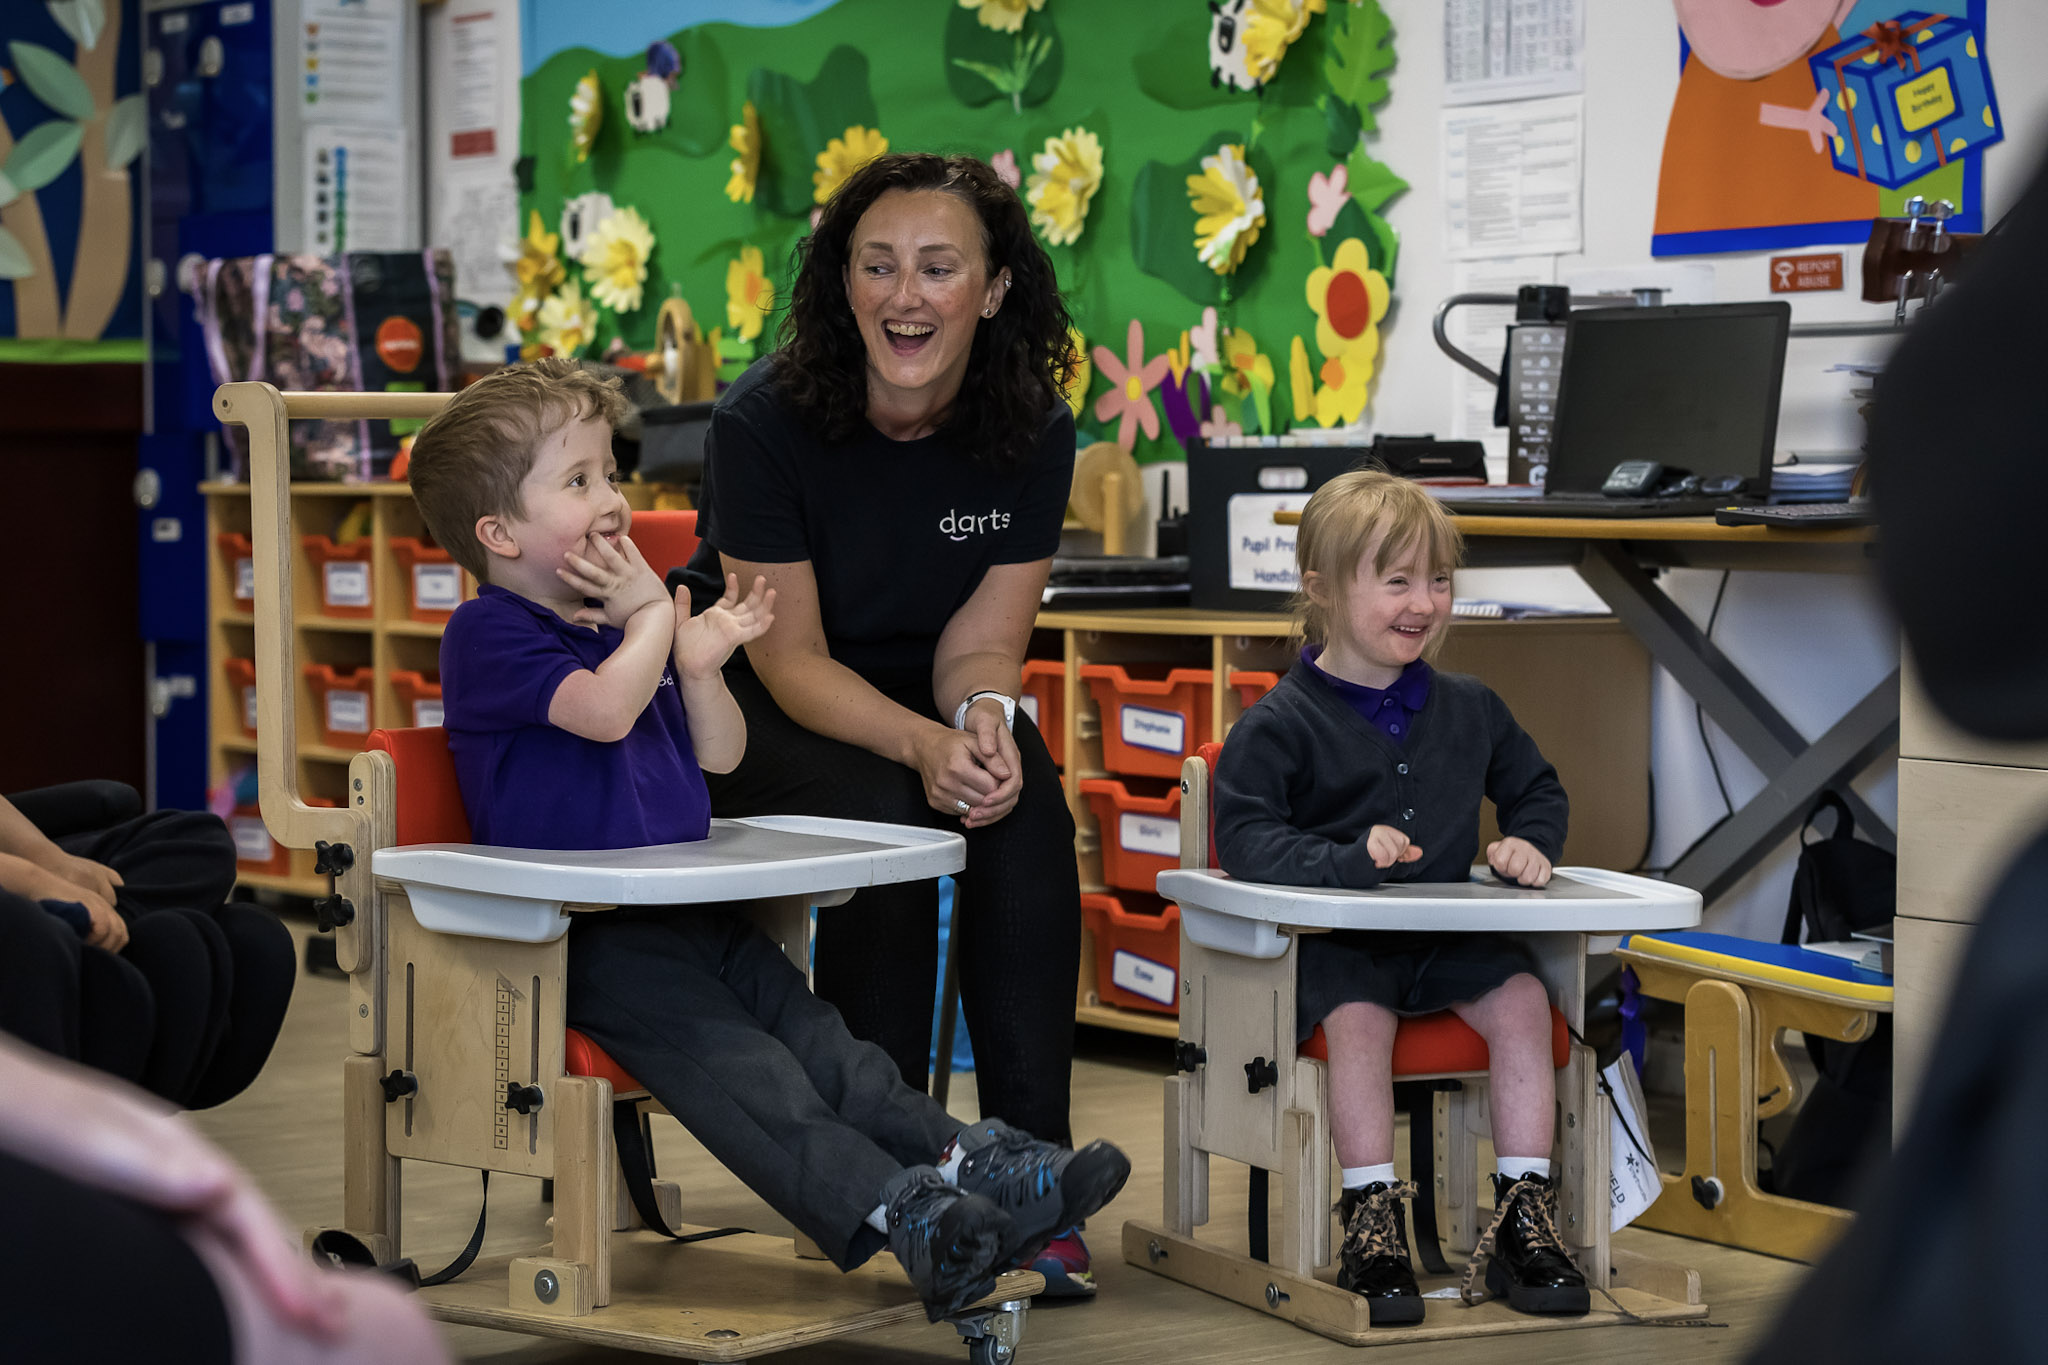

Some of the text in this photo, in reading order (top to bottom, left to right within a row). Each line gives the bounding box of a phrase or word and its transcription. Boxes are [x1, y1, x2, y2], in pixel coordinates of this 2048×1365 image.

[1796, 258, 1837, 273] REPORT
[1797, 274, 1832, 288] ABUSE
[939, 508, 1011, 535] darts
[1242, 536, 1270, 555] Pupil
